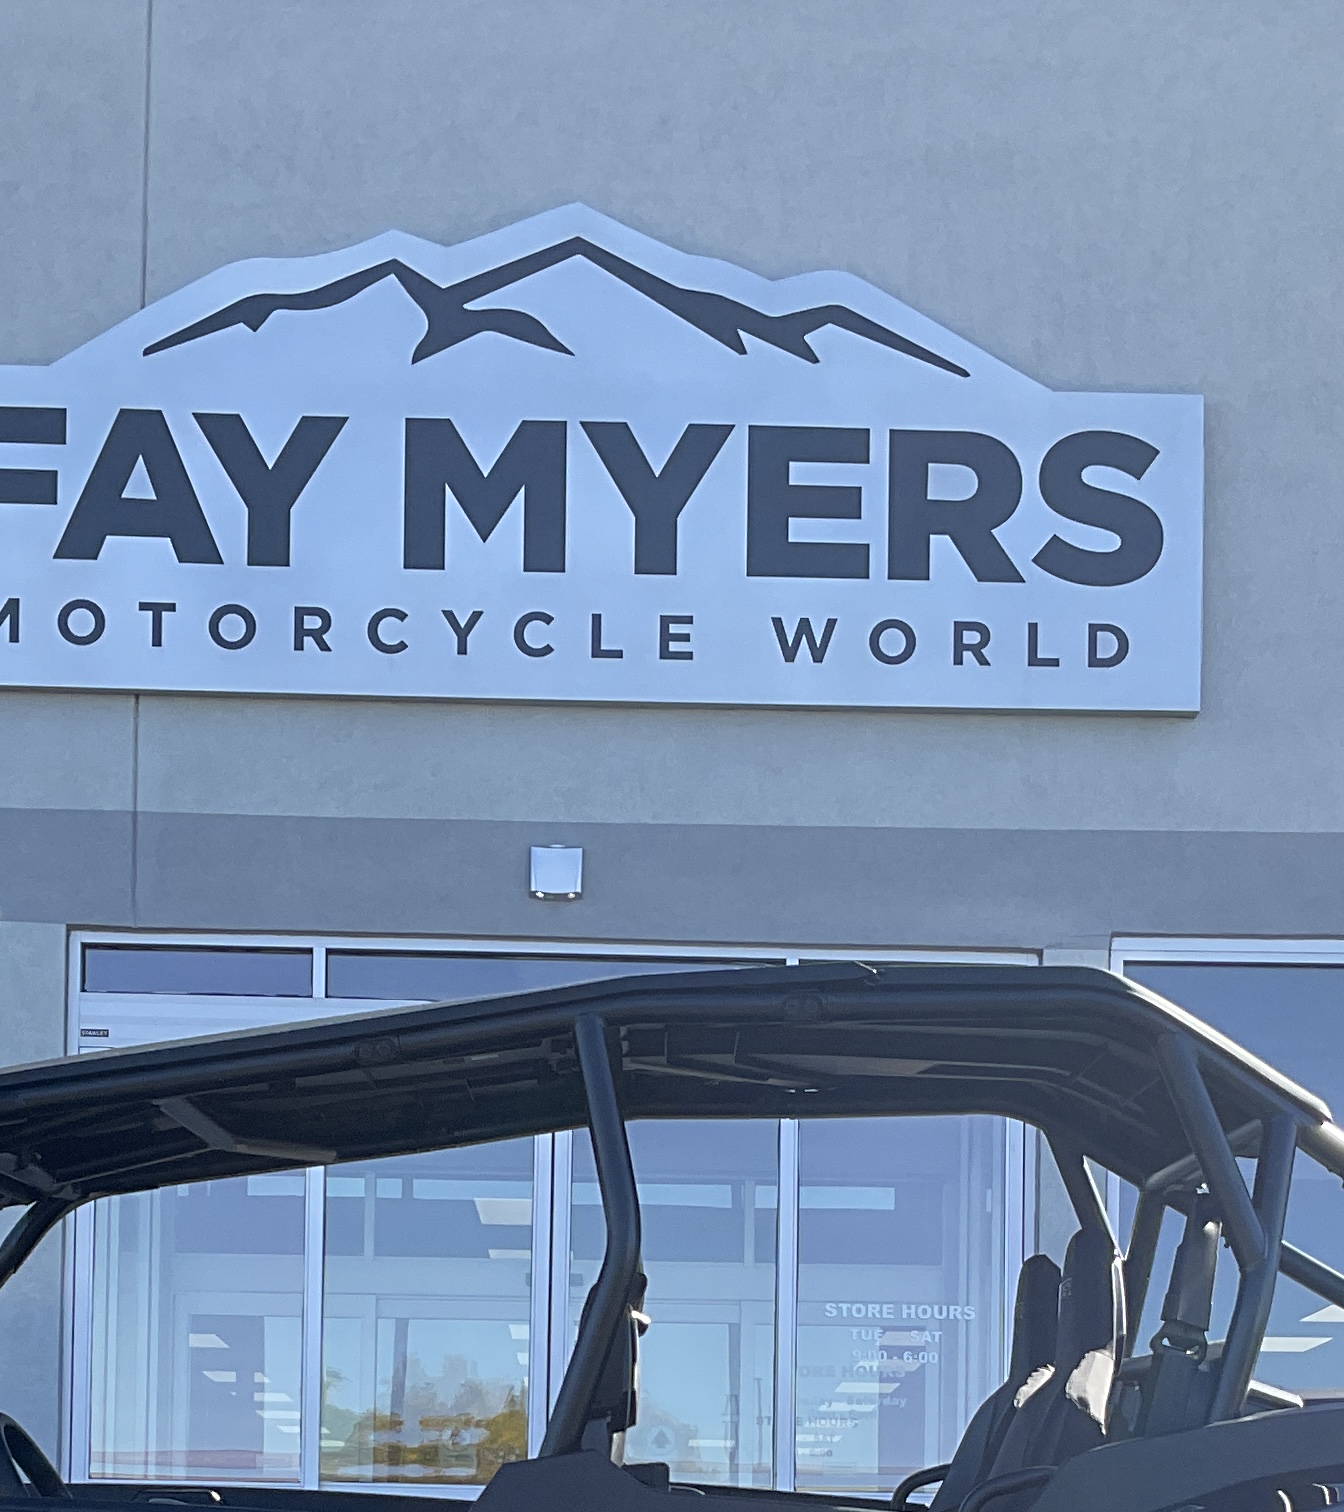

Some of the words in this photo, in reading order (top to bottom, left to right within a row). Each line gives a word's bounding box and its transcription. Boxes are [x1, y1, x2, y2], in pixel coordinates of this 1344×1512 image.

[402, 416, 1165, 588] MYERS
[770, 615, 1131, 669] WORLD
[824, 1302, 895, 1319] STORE
[902, 1304, 976, 1320] HOURS
[910, 1330, 943, 1343] SAT
[903, 1351, 939, 1364] 6:00
